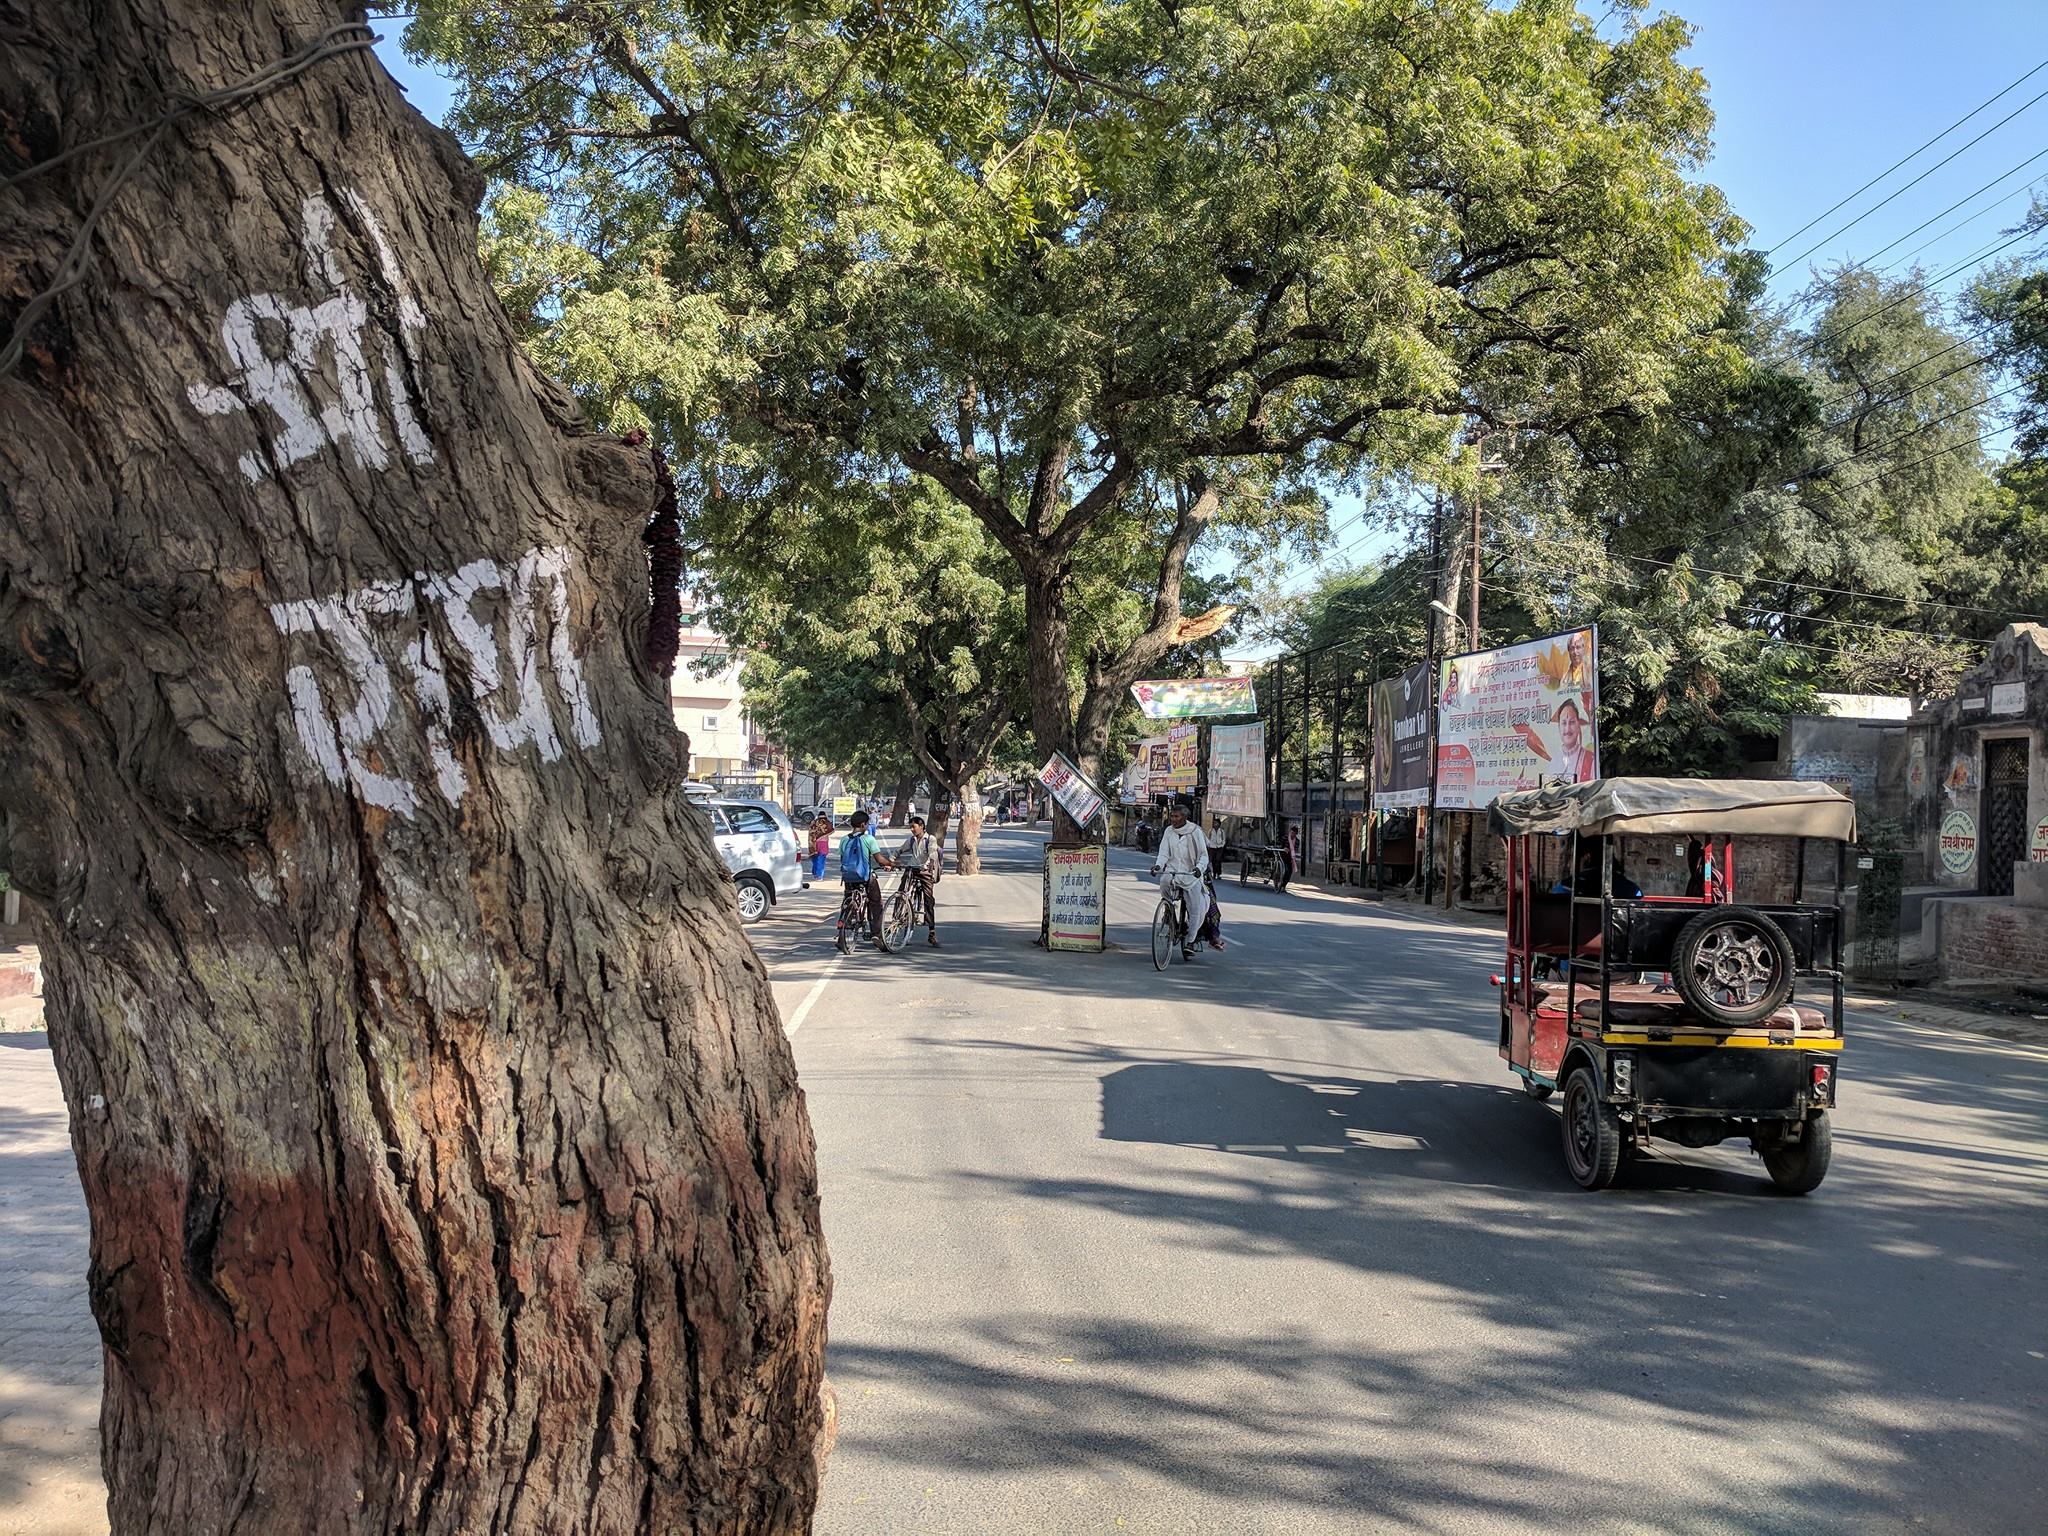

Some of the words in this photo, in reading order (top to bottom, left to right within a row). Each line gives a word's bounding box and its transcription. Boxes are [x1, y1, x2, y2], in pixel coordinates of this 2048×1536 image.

[187, 186, 437, 484] श्री
[1521, 655, 1539, 671] कथा
[1082, 853, 1099, 865] भवन
